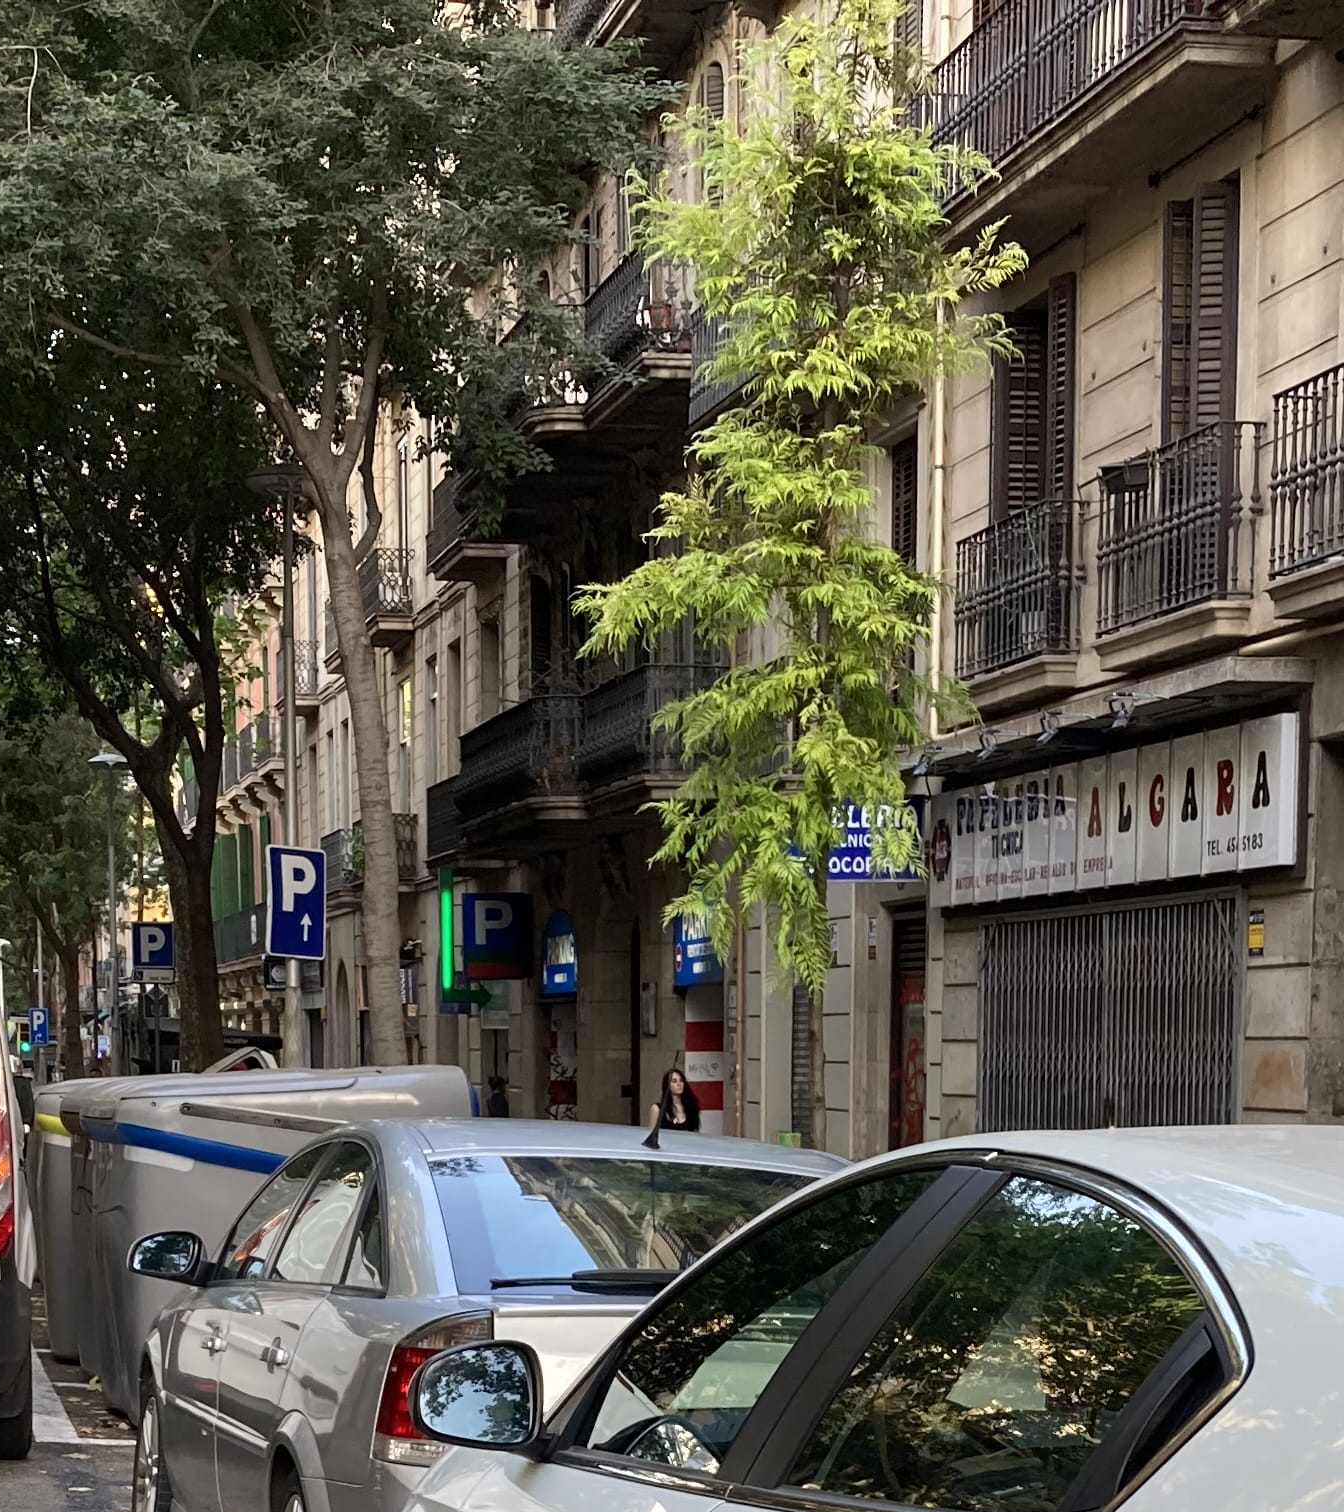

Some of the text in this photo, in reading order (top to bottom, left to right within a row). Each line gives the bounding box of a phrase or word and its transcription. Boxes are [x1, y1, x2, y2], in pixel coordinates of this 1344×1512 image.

[1087, 751, 1270, 838] ALGARA
[1206, 840, 1223, 857] TEL.
[280, 854, 317, 912] P
[474, 899, 513, 945] P
[140, 926, 166, 963] P
[32, 1010, 45, 1031] P
